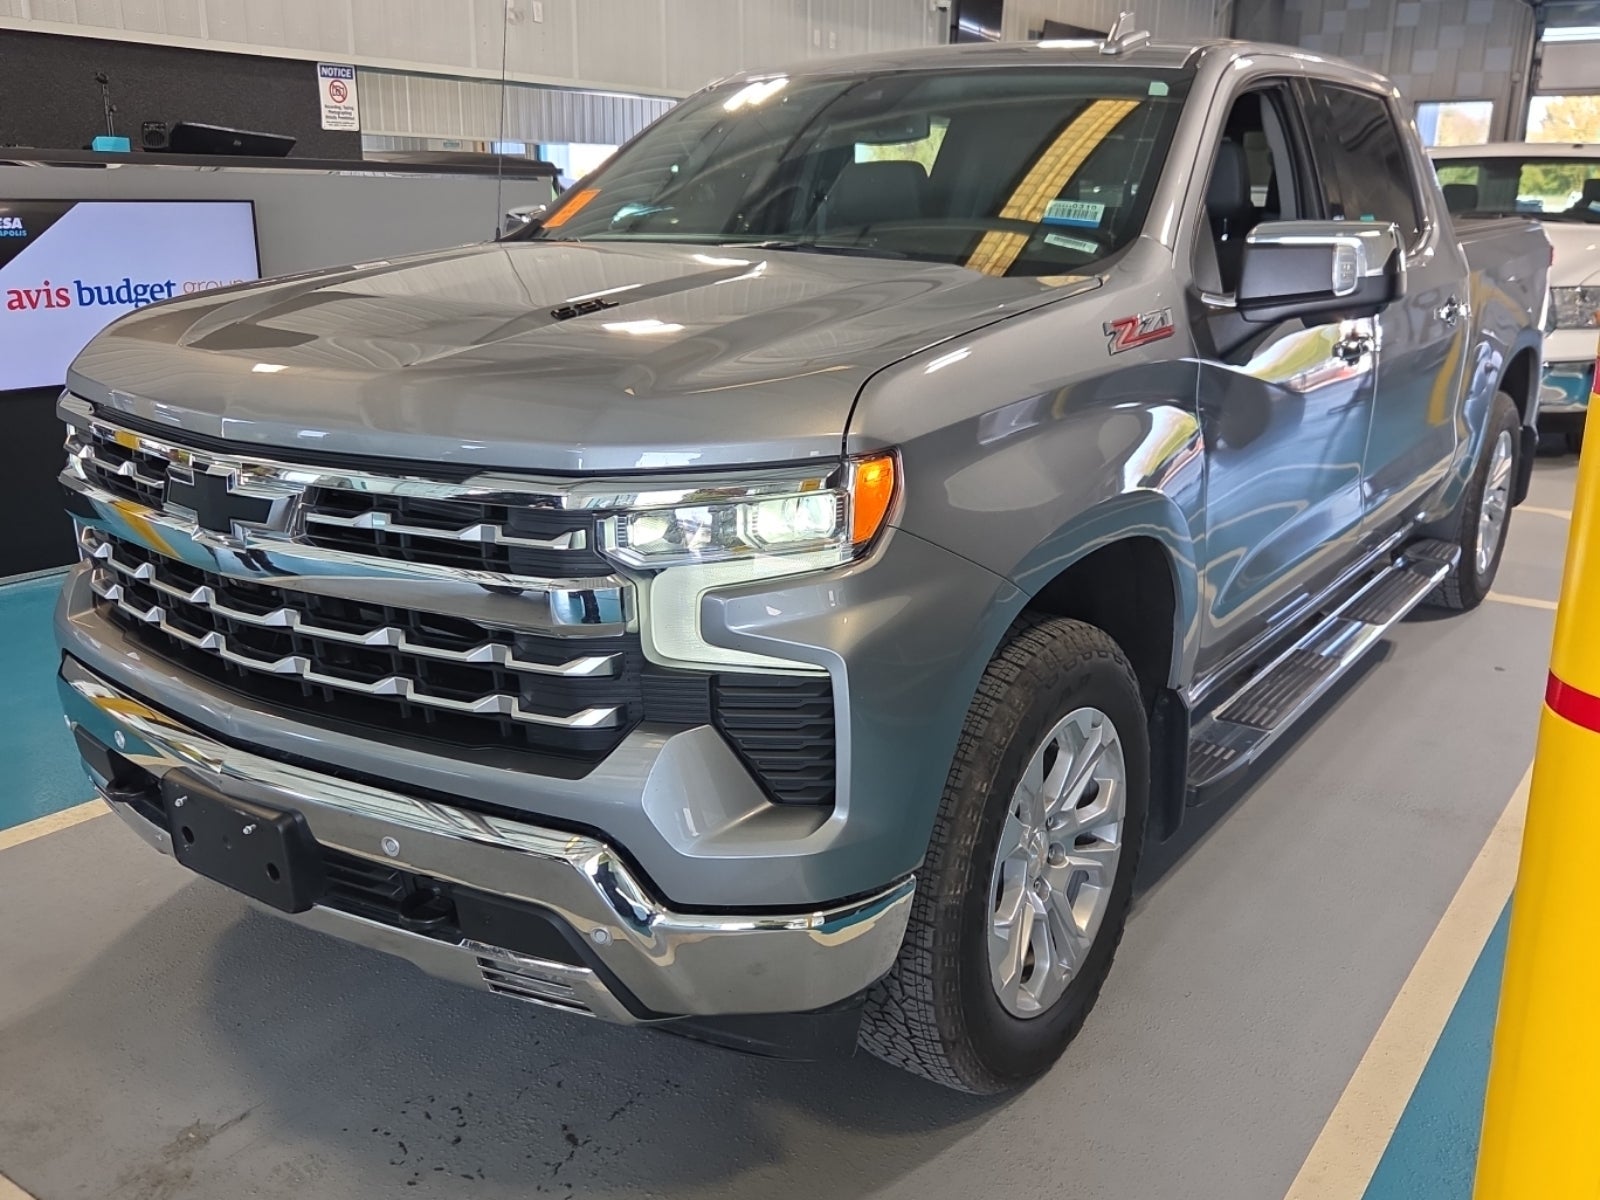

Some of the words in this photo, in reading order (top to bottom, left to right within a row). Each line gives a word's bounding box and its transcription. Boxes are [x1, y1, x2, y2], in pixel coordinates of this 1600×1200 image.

[321, 67, 352, 78] NOTICE
[0, 217, 23, 229] SA
[7, 280, 71, 310] avis
[74, 278, 176, 308] budget
[183, 279, 244, 295] gro
[1103, 306, 1175, 356] Z71
